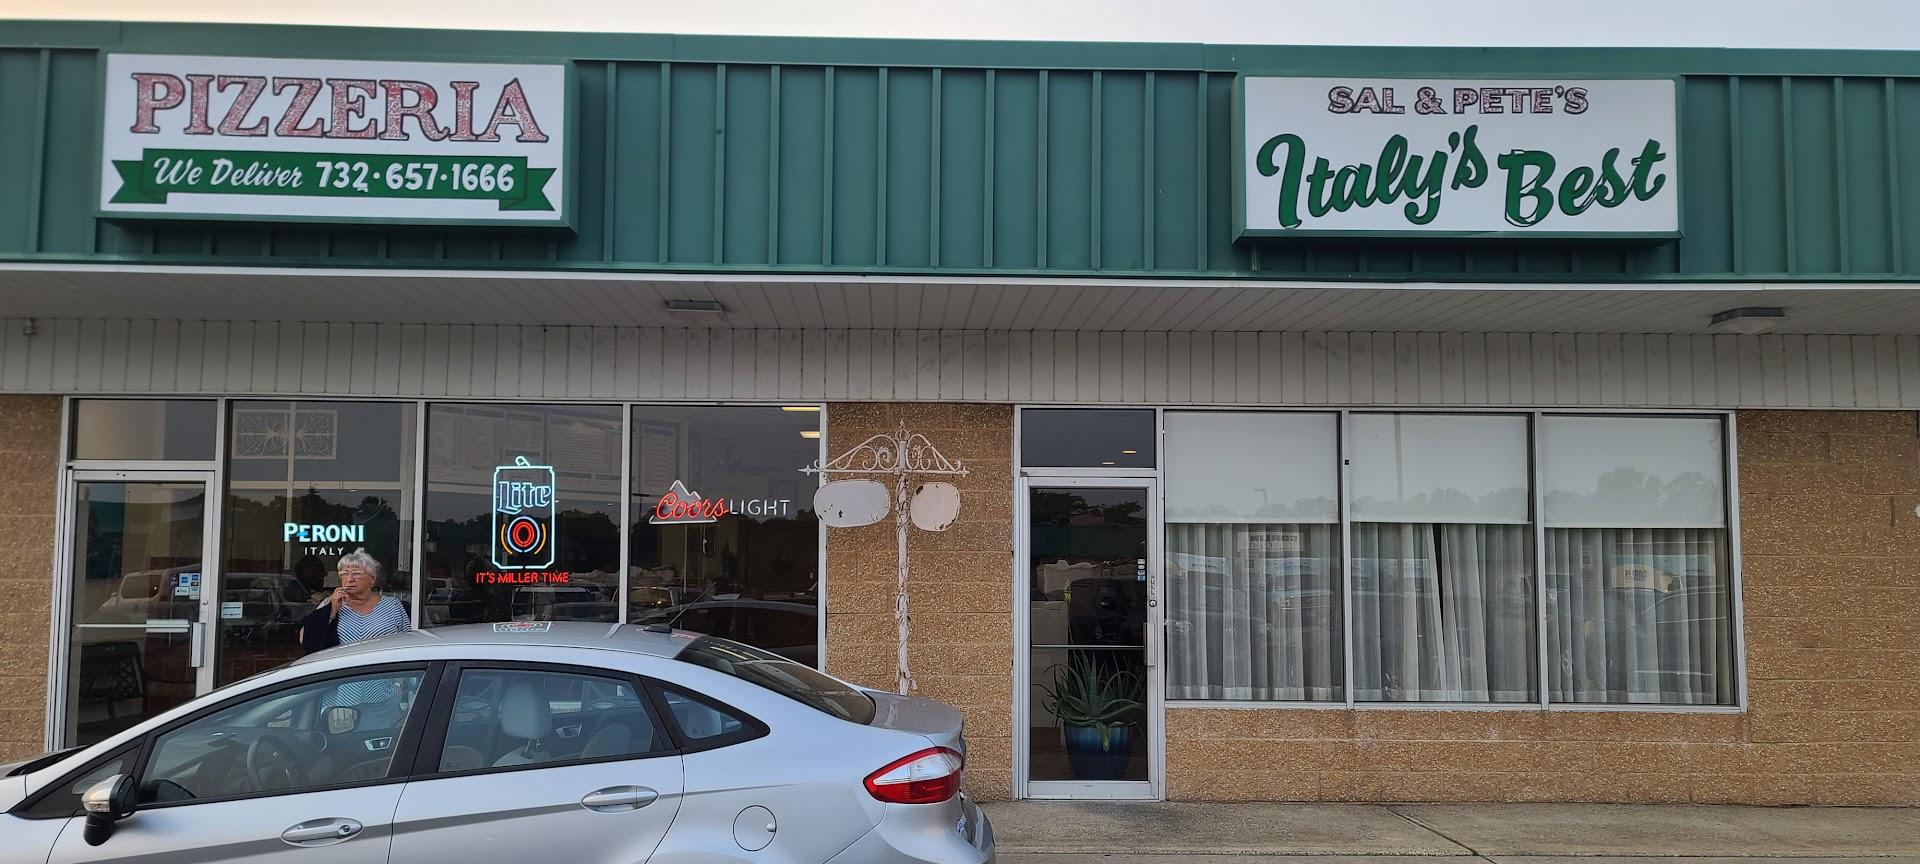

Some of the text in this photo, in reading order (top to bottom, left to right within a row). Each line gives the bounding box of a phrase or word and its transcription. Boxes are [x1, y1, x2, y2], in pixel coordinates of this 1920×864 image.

[130, 73, 549, 143] PIZZERIA
[1328, 85, 1589, 115] SAL & PETE'S
[153, 157, 203, 186] We
[211, 158, 303, 188] Deliver
[1256, 125, 1667, 228] Italy's Best
[496, 480, 552, 515] Lite
[655, 491, 791, 520] Coors LIGHT
[283, 522, 365, 543] PERONI
[304, 546, 344, 556] ITALY
[475, 572, 570, 584] IT'S MILLER TIME
